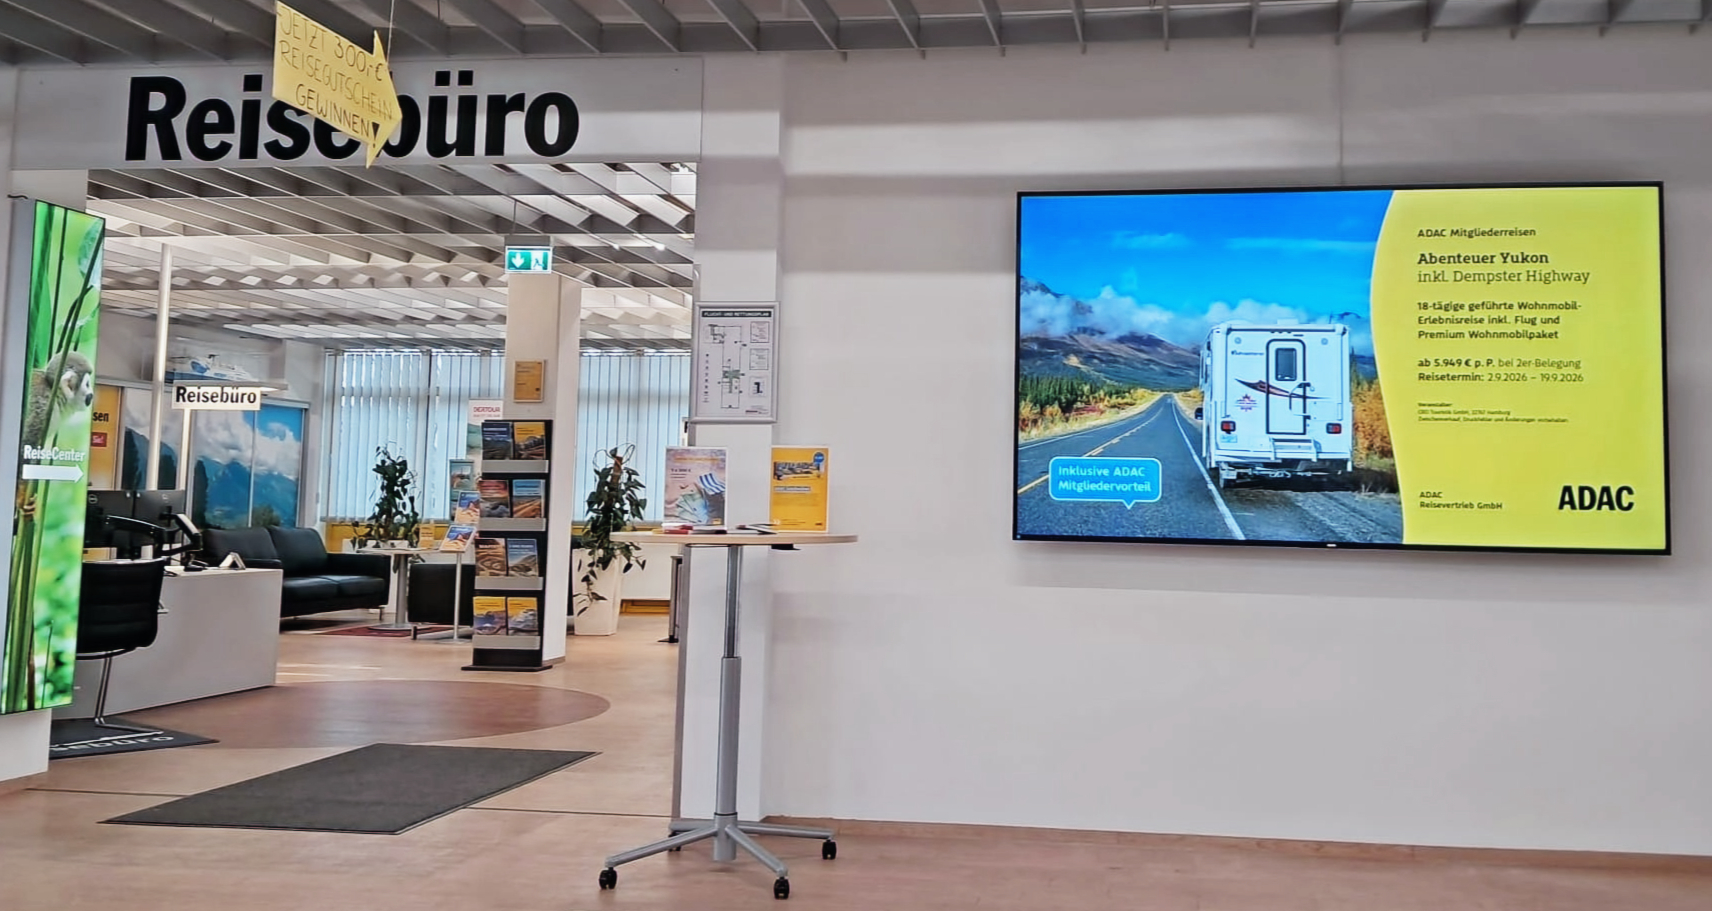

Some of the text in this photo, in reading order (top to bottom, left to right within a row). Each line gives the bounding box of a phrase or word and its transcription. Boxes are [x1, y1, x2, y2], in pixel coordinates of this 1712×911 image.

[280, 6, 326, 51] JETZT
[279, 40, 392, 120] REISEGUTSCHEIN
[1418, 228, 1536, 238] ADAC Mitgliederreisen
[1418, 252, 1549, 264] Abenteuer Yukon
[1418, 270, 1590, 285] inkl. Dempster Highway
[1418, 301, 1582, 312] 18-tägige geführte Wohnmobil-
[1418, 315, 1560, 326] Erlebnisreise inkl. Flug und
[1418, 330, 1558, 340] Premium Wohnmobilpaket
[1418, 359, 1581, 369] ab 5.949 € p. P. bei 2er-Belegung
[1418, 373, 1484, 381] Reisetermin:
[1488, 373, 1527, 382] 2.9.2026
[1540, 373, 1583, 382] 19.9.2026
[176, 386, 256, 404] Reisebüro
[93, 411, 109, 422] sen
[24, 445, 86, 462] ReiseCenter
[1059, 466, 1145, 477] Inklusive ADAC
[1059, 480, 1151, 492] Mitgliedervorteil
[1559, 486, 1634, 511] ADAC
